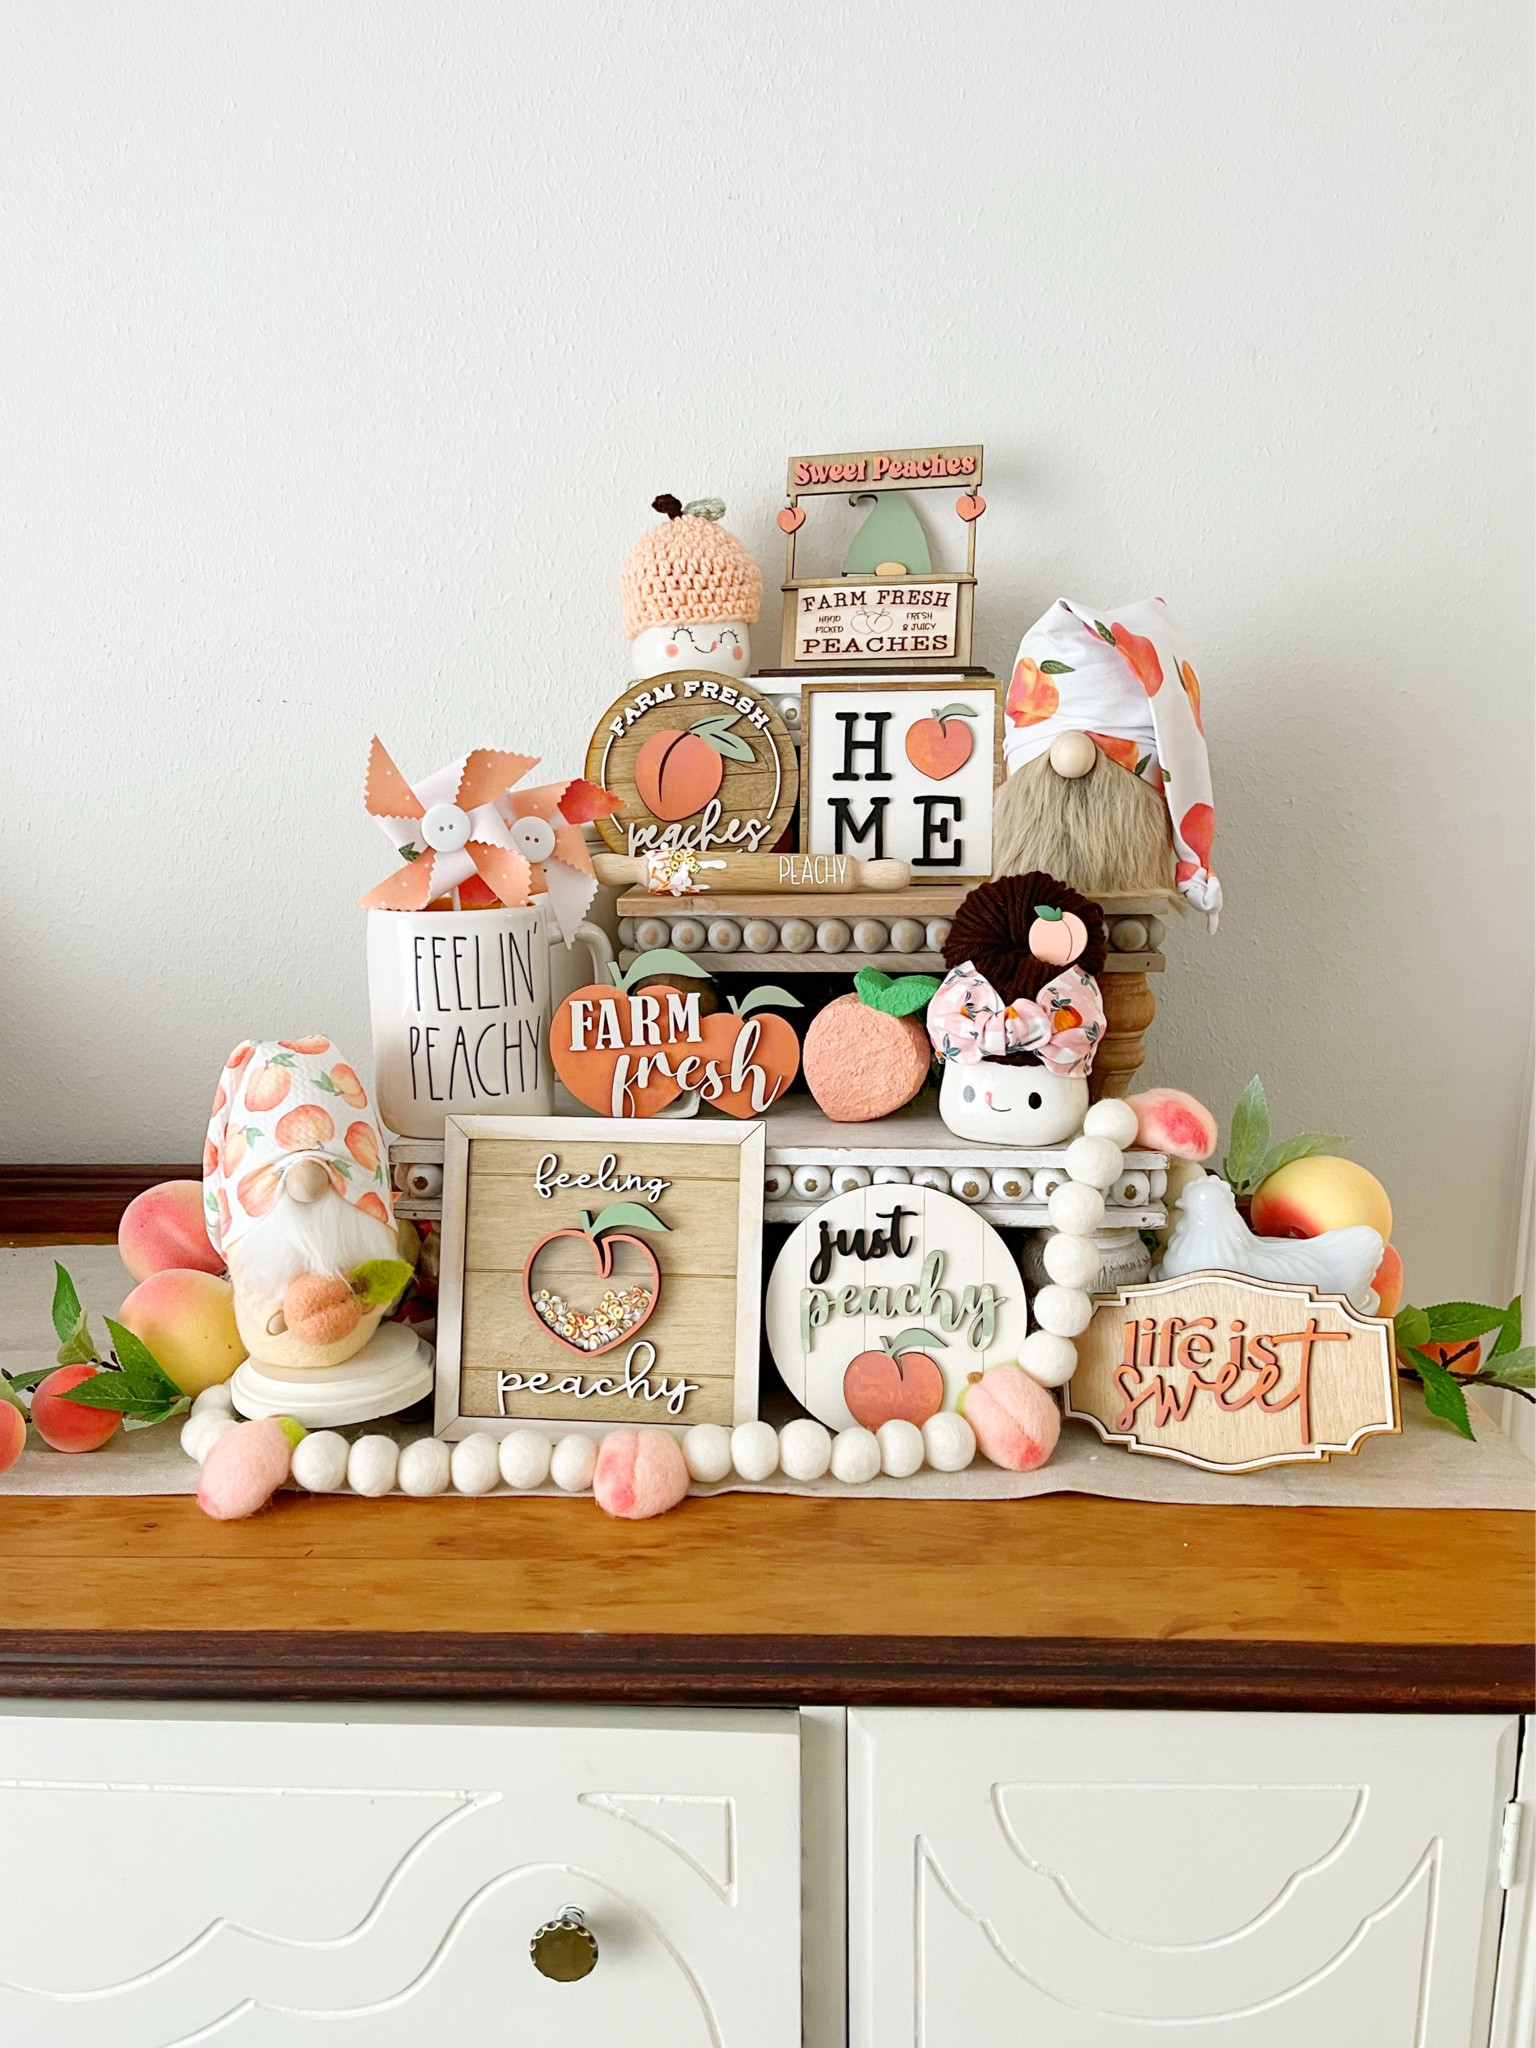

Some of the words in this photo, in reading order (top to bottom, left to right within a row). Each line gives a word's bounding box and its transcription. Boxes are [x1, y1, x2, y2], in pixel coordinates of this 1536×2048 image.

[795, 461, 867, 486] Sweet
[872, 453, 976, 481] Peaches
[802, 591, 867, 612] FARM
[877, 590, 951, 608] FRESH
[815, 625, 844, 634] PICKED
[906, 612, 933, 620] FRESH
[911, 622, 937, 631] JUICY
[802, 634, 948, 654] PEACHES
[609, 682, 675, 739] FARM
[684, 681, 770, 731] FRESH
[628, 798, 771, 855] peaches
[779, 856, 848, 886] PEACHY
[413, 921, 538, 1012] FEELIN'
[568, 992, 702, 1051] FARM
[409, 1015, 541, 1101] PEACHY
[611, 1019, 783, 1118] fresh
[533, 1153, 672, 1203] feeling
[810, 1205, 918, 1285] just
[800, 1250, 1008, 1353] peachy
[1123, 1317, 1216, 1369] life
[1230, 1318, 1278, 1371] is
[497, 1340, 699, 1416] peachy
[1113, 1318, 1350, 1445] sweet
